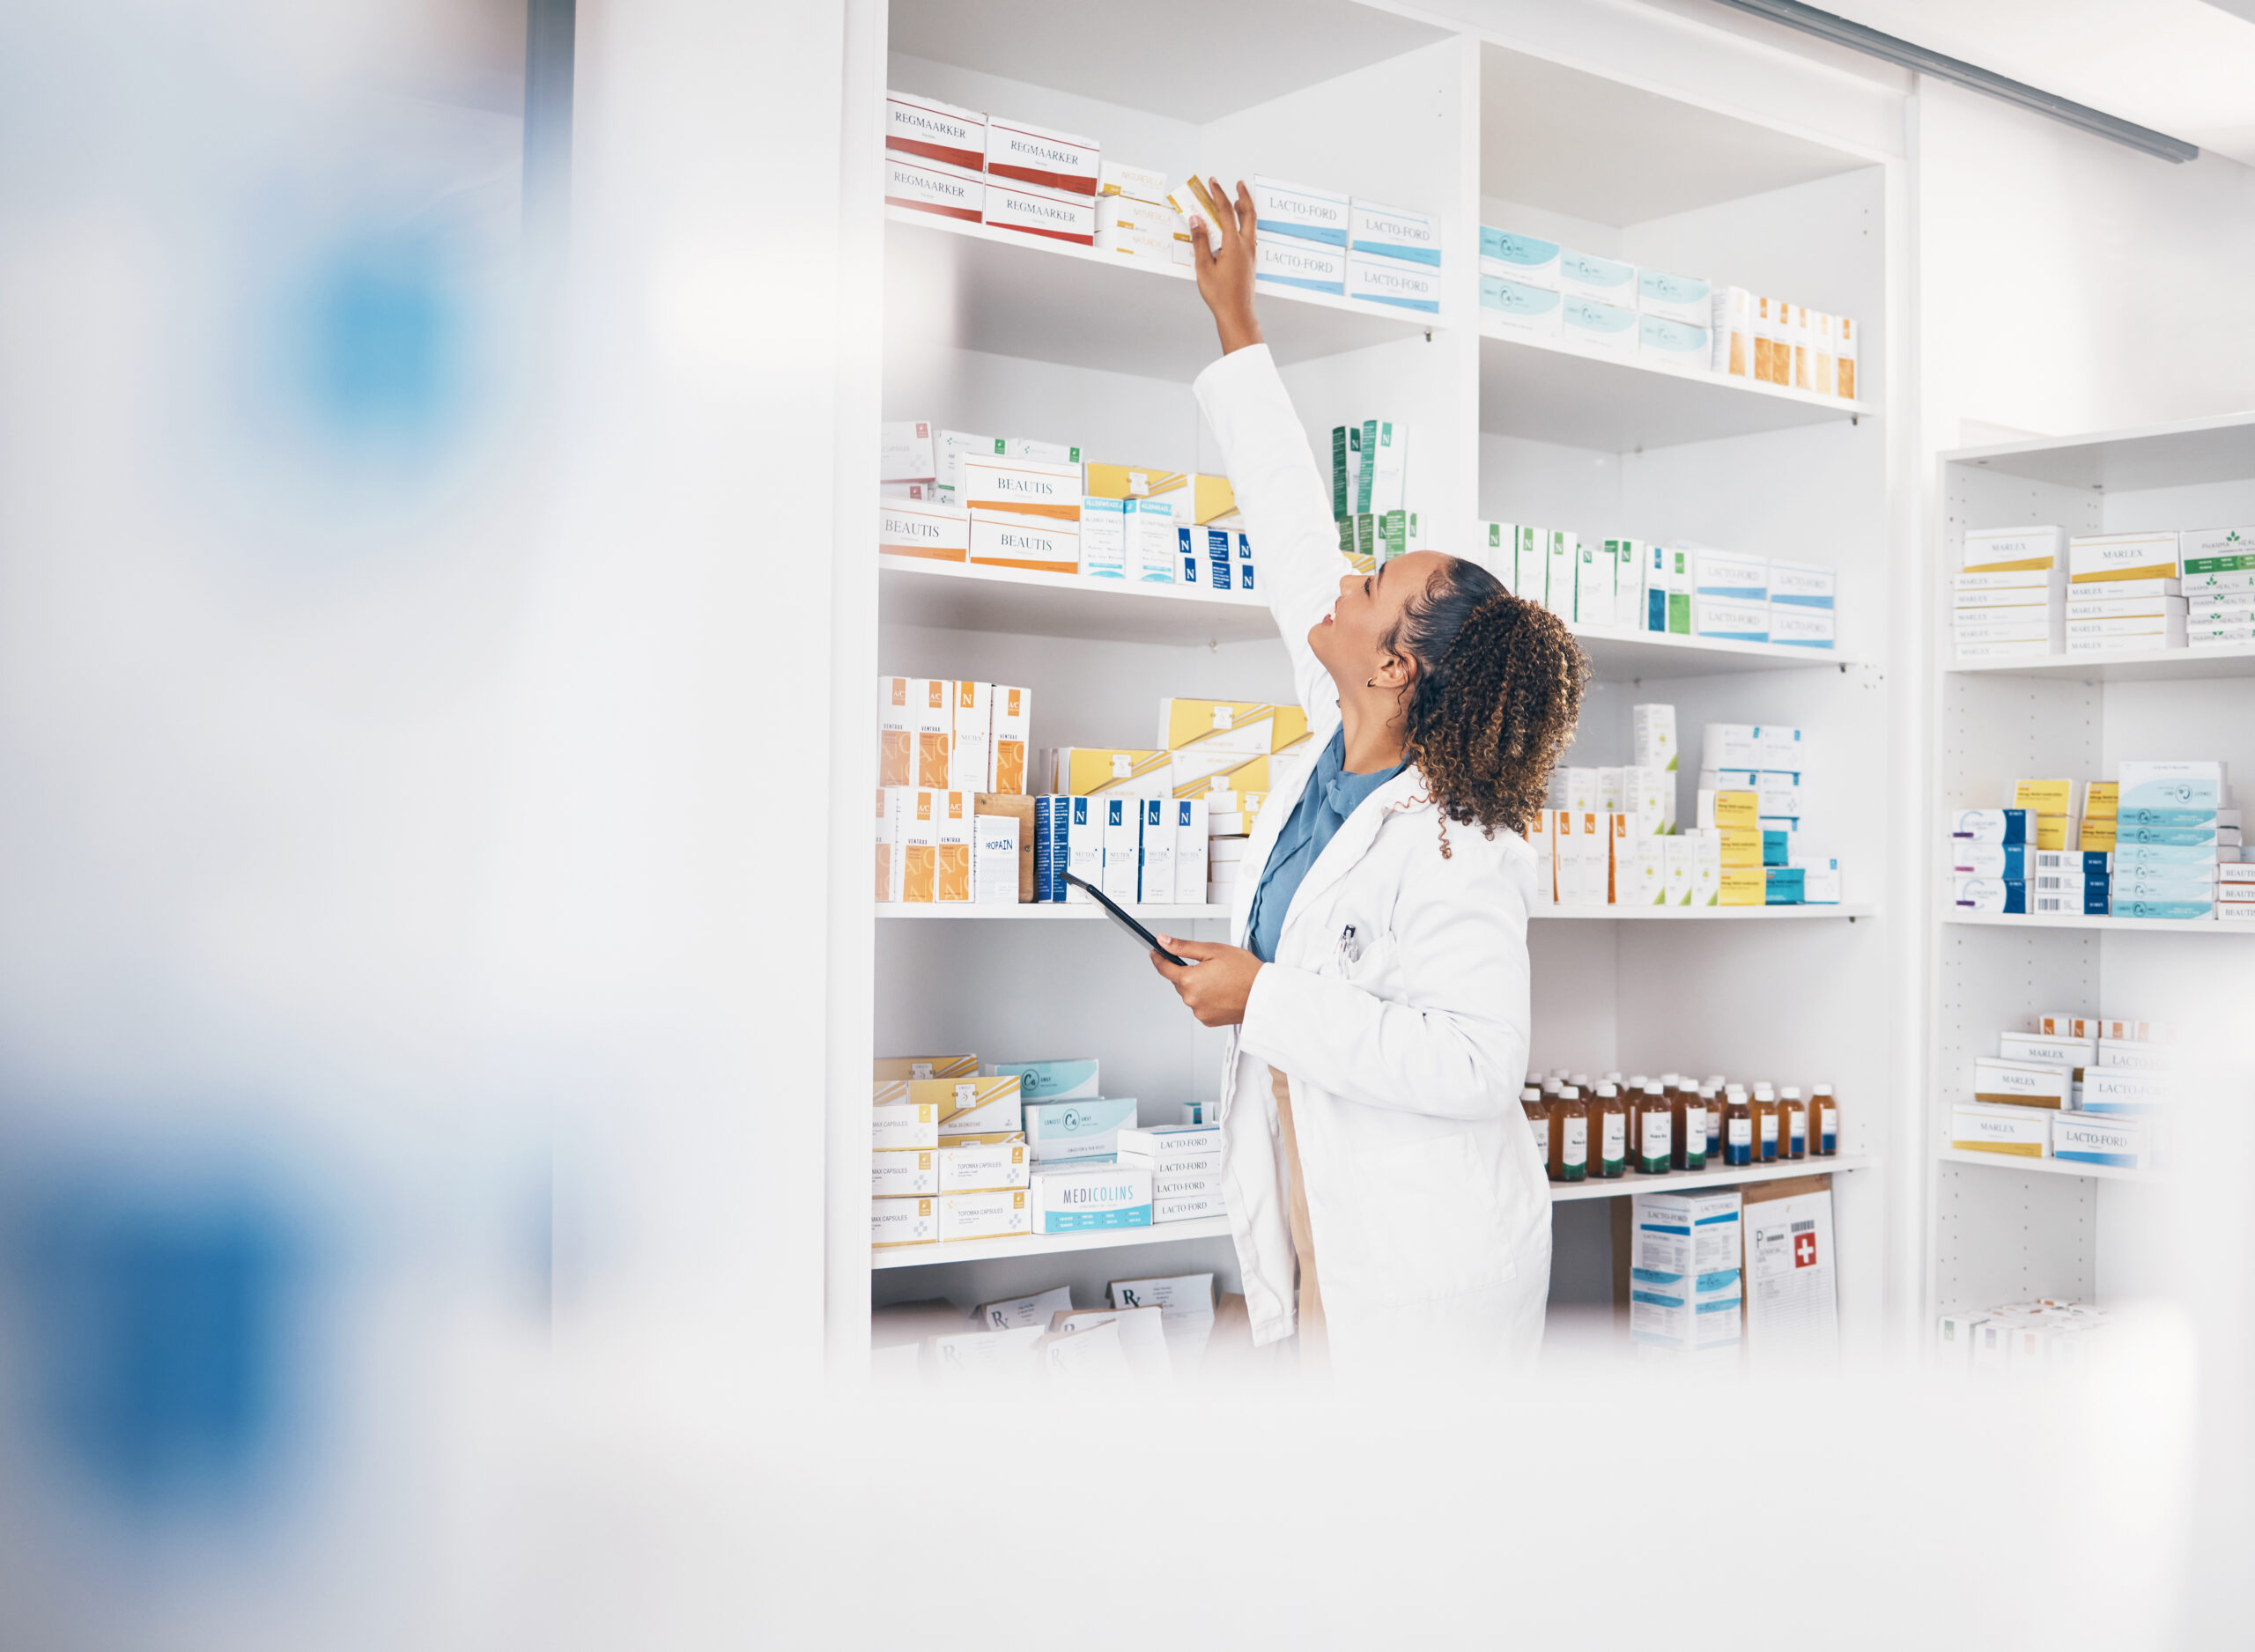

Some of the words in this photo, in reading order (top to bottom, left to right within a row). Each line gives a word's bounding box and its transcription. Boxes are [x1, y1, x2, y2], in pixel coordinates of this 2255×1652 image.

[895, 111, 965, 139] REGMAARKER
[1011, 140, 1078, 166] REGMAARKER
[894, 172, 965, 197] REGMAARKER
[1007, 199, 1076, 223] REGMAARKER
[1270, 197, 1336, 220] LACTO-FORD
[1366, 218, 1430, 241] LACTO-FORD
[1266, 250, 1333, 274] LACTO-FORD
[1364, 272, 1429, 293] LACTO-FORD
[998, 477, 1053, 494] BEAUTIS
[885, 520, 939, 537] BEAUTIS
[1001, 534, 1052, 550] BEAUTIS
[1490, 535, 1498, 545] N
[1525, 540, 1532, 549] N
[1181, 541, 1189, 550] N
[1556, 544, 1563, 553] N
[1992, 542, 2026, 551] MARLEX
[1241, 546, 1249, 556] N
[1585, 551, 1591, 561] N
[1623, 551, 1630, 560] N
[2103, 549, 2143, 559] MARLEX
[1187, 569, 1194, 579] N
[1245, 577, 1252, 586] N
[963, 694, 972, 704] N
[1076, 811, 1084, 822] N
[1111, 813, 1120, 822] N
[1150, 812, 1158, 822] N
[1181, 813, 1189, 823] N
[1534, 821, 1541, 830] N
[1562, 823, 1568, 832] N
[1586, 822, 1593, 831] N
[1618, 826, 1624, 835] N
[986, 839, 1013, 850] PROPAIN
[2029, 1049, 2064, 1058] MARLEX
[2002, 1075, 2036, 1086] MARLEX
[1980, 1123, 2015, 1133] MARLEX
[1160, 1139, 1208, 1149] LACTO-FORD
[2066, 1132, 2126, 1147] LACTO-FORD
[1159, 1162, 1207, 1172] LACTO-FORD
[1157, 1182, 1205, 1193] LACTO-FORD
[1063, 1185, 1134, 1204] MEDICOLINS
[1162, 1202, 1207, 1214] LACTO-FORD
[1701, 1202, 1734, 1212] LACTO-FORD
[1648, 1211, 1688, 1222] LACTO-FORD
